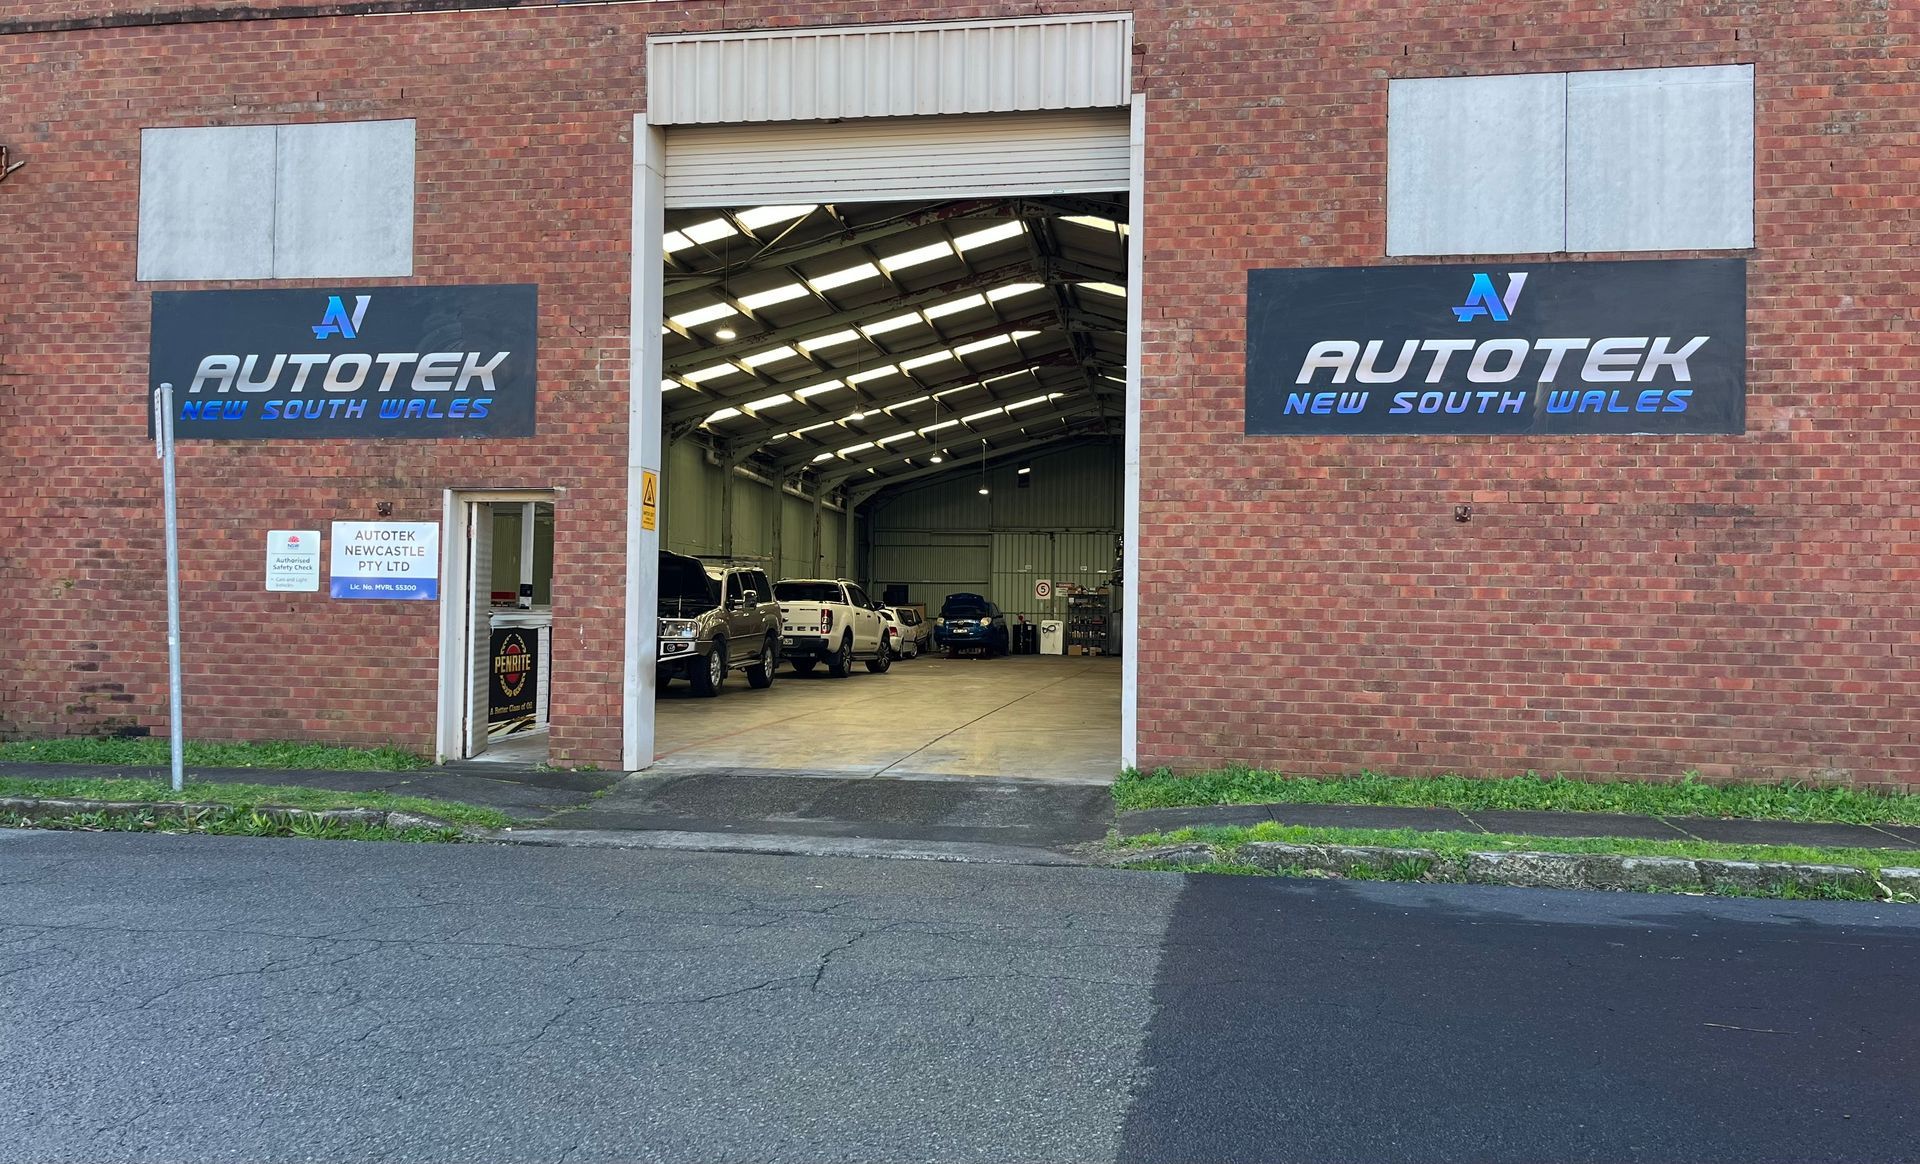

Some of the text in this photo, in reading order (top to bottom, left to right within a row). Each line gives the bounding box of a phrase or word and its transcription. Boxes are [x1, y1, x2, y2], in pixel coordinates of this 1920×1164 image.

[1295, 336, 1711, 384] AUTOTEK
[188, 351, 511, 393] AUTOTEK
[180, 398, 493, 420] NEW SOUTH WALES
[1283, 389, 1693, 415] NEW SOUTH WALES
[355, 530, 415, 541] AUTOTEK
[345, 545, 425, 556] NEWCASTLE
[358, 561, 410, 571] PTY LTD
[494, 654, 531, 673] PENRITE
